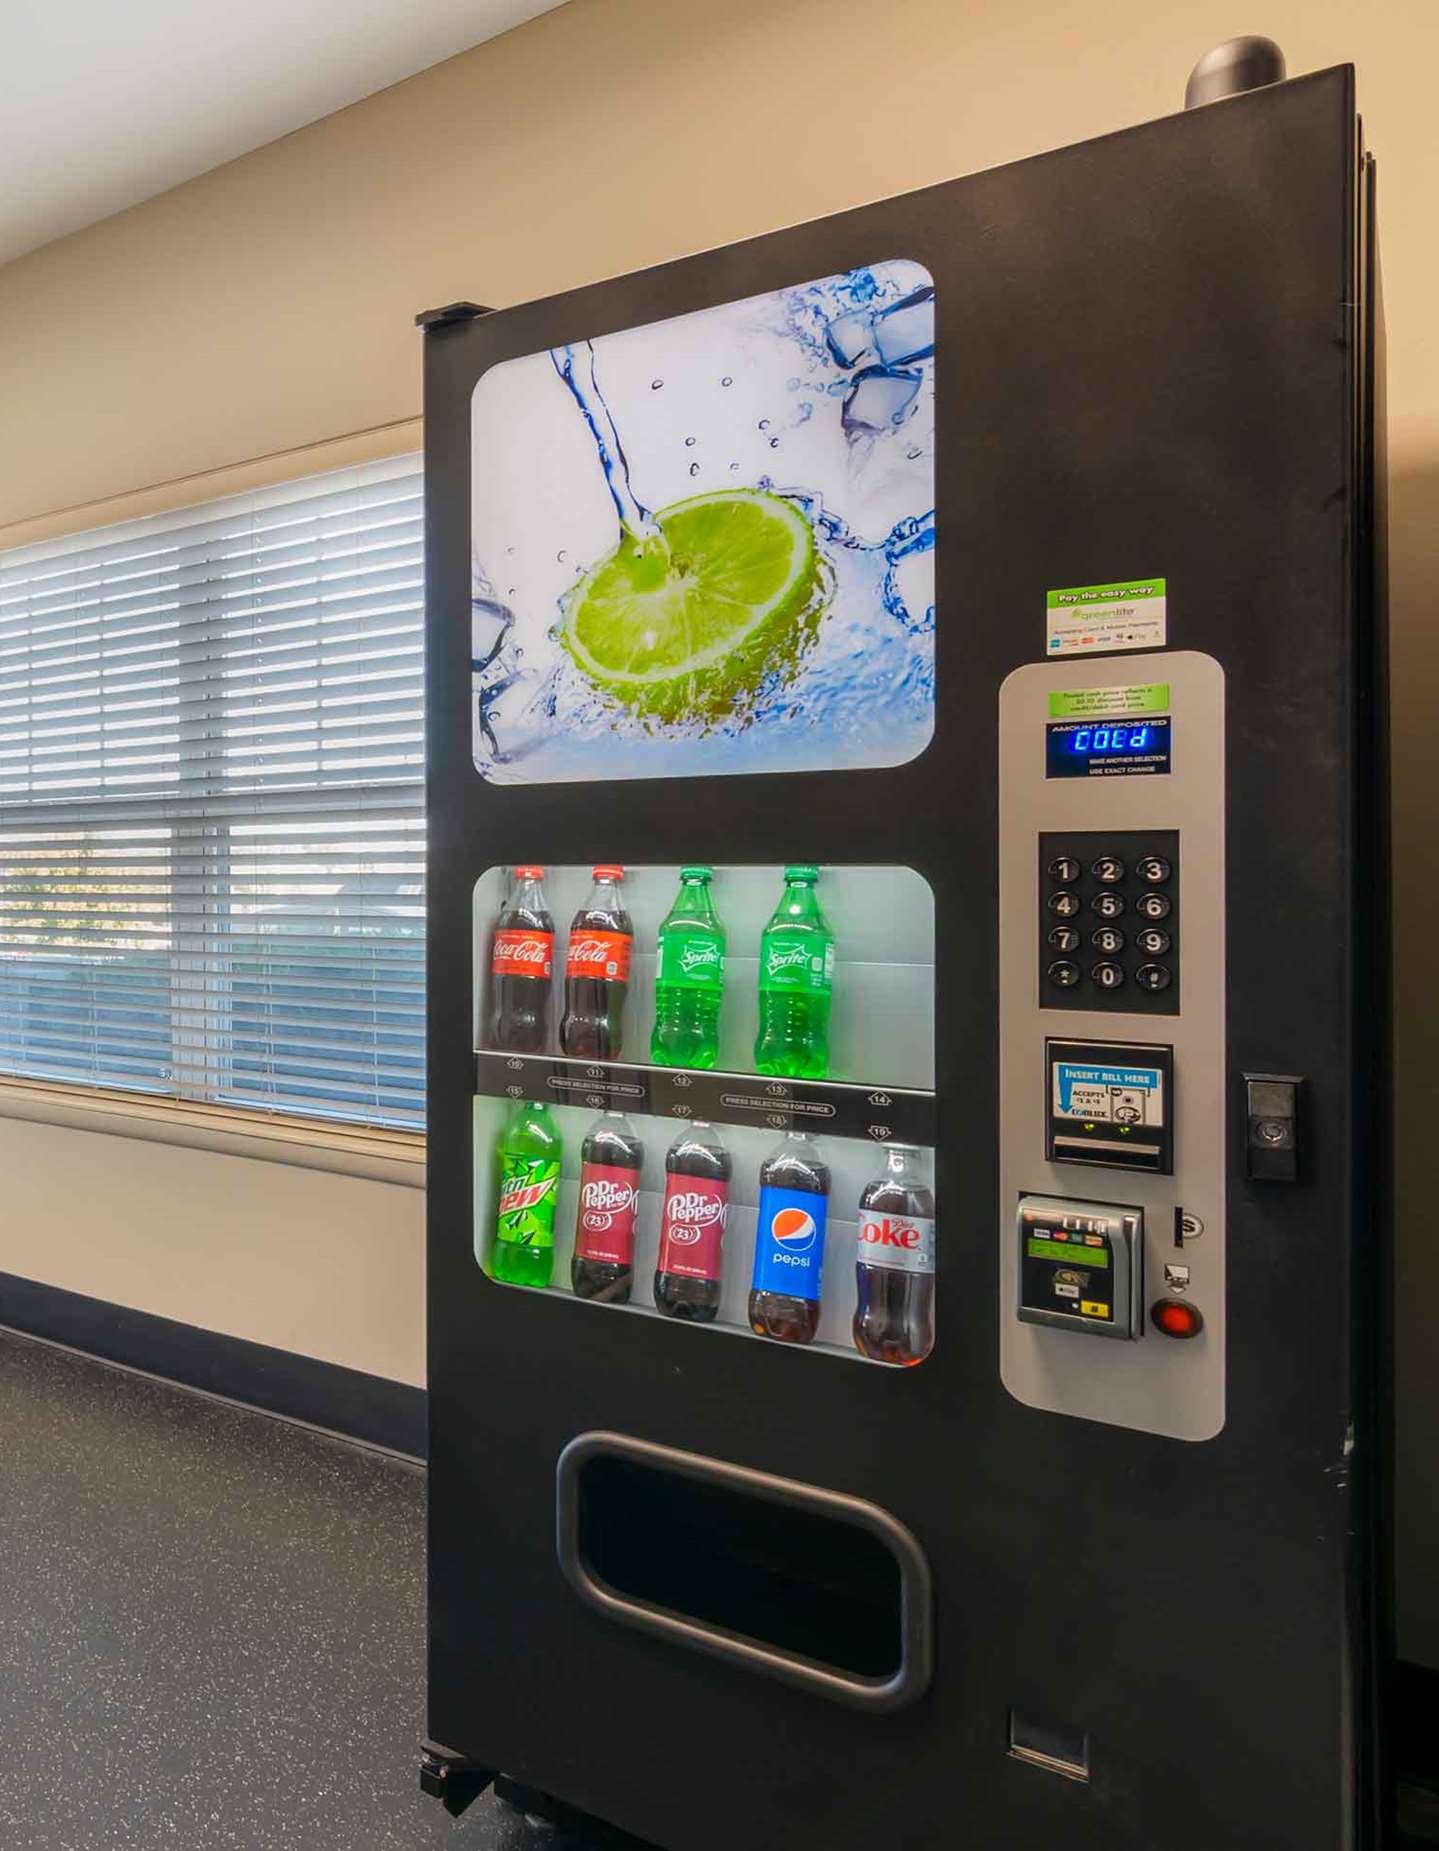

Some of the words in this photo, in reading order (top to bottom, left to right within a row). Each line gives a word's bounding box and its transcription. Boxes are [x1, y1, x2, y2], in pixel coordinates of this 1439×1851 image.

[1058, 594, 1078, 603] Pay
[1081, 591, 1098, 600] the
[1100, 590, 1125, 598] easy
[1129, 586, 1153, 595] way
[1052, 723, 1099, 732] AMOUNT
[1103, 720, 1167, 728] DEPOSITED
[1059, 862, 1068, 879] 1
[1102, 863, 1115, 879] 2
[1147, 862, 1161, 879] 3
[1057, 897, 1071, 913] 4
[1101, 898, 1115, 914] 5
[1146, 898, 1161, 915] 6
[1058, 932, 1071, 949] 7
[1102, 933, 1115, 949] 8
[1146, 933, 1161, 951] 9
[683, 951, 716, 965] Sprite
[769, 953, 806, 966] Sprite
[1102, 968, 1114, 985] 0
[1065, 1069, 1099, 1080] INSERT
[1102, 1073, 1122, 1082] BILL
[1124, 1075, 1151, 1084] HERE
[1072, 1090, 1105, 1098] ACCEPTS
[725, 1097, 748, 1105] PRESS
[750, 1099, 789, 1109] SELECTION
[807, 1105, 829, 1113] PRICE
[598, 1180, 619, 1194] Dr
[586, 1183, 629, 1210] Pepper
[686, 1192, 708, 1207] Dr
[672, 1194, 719, 1223] Pepper
[857, 1212, 920, 1249] oke
[773, 1253, 810, 1267] pepsi
